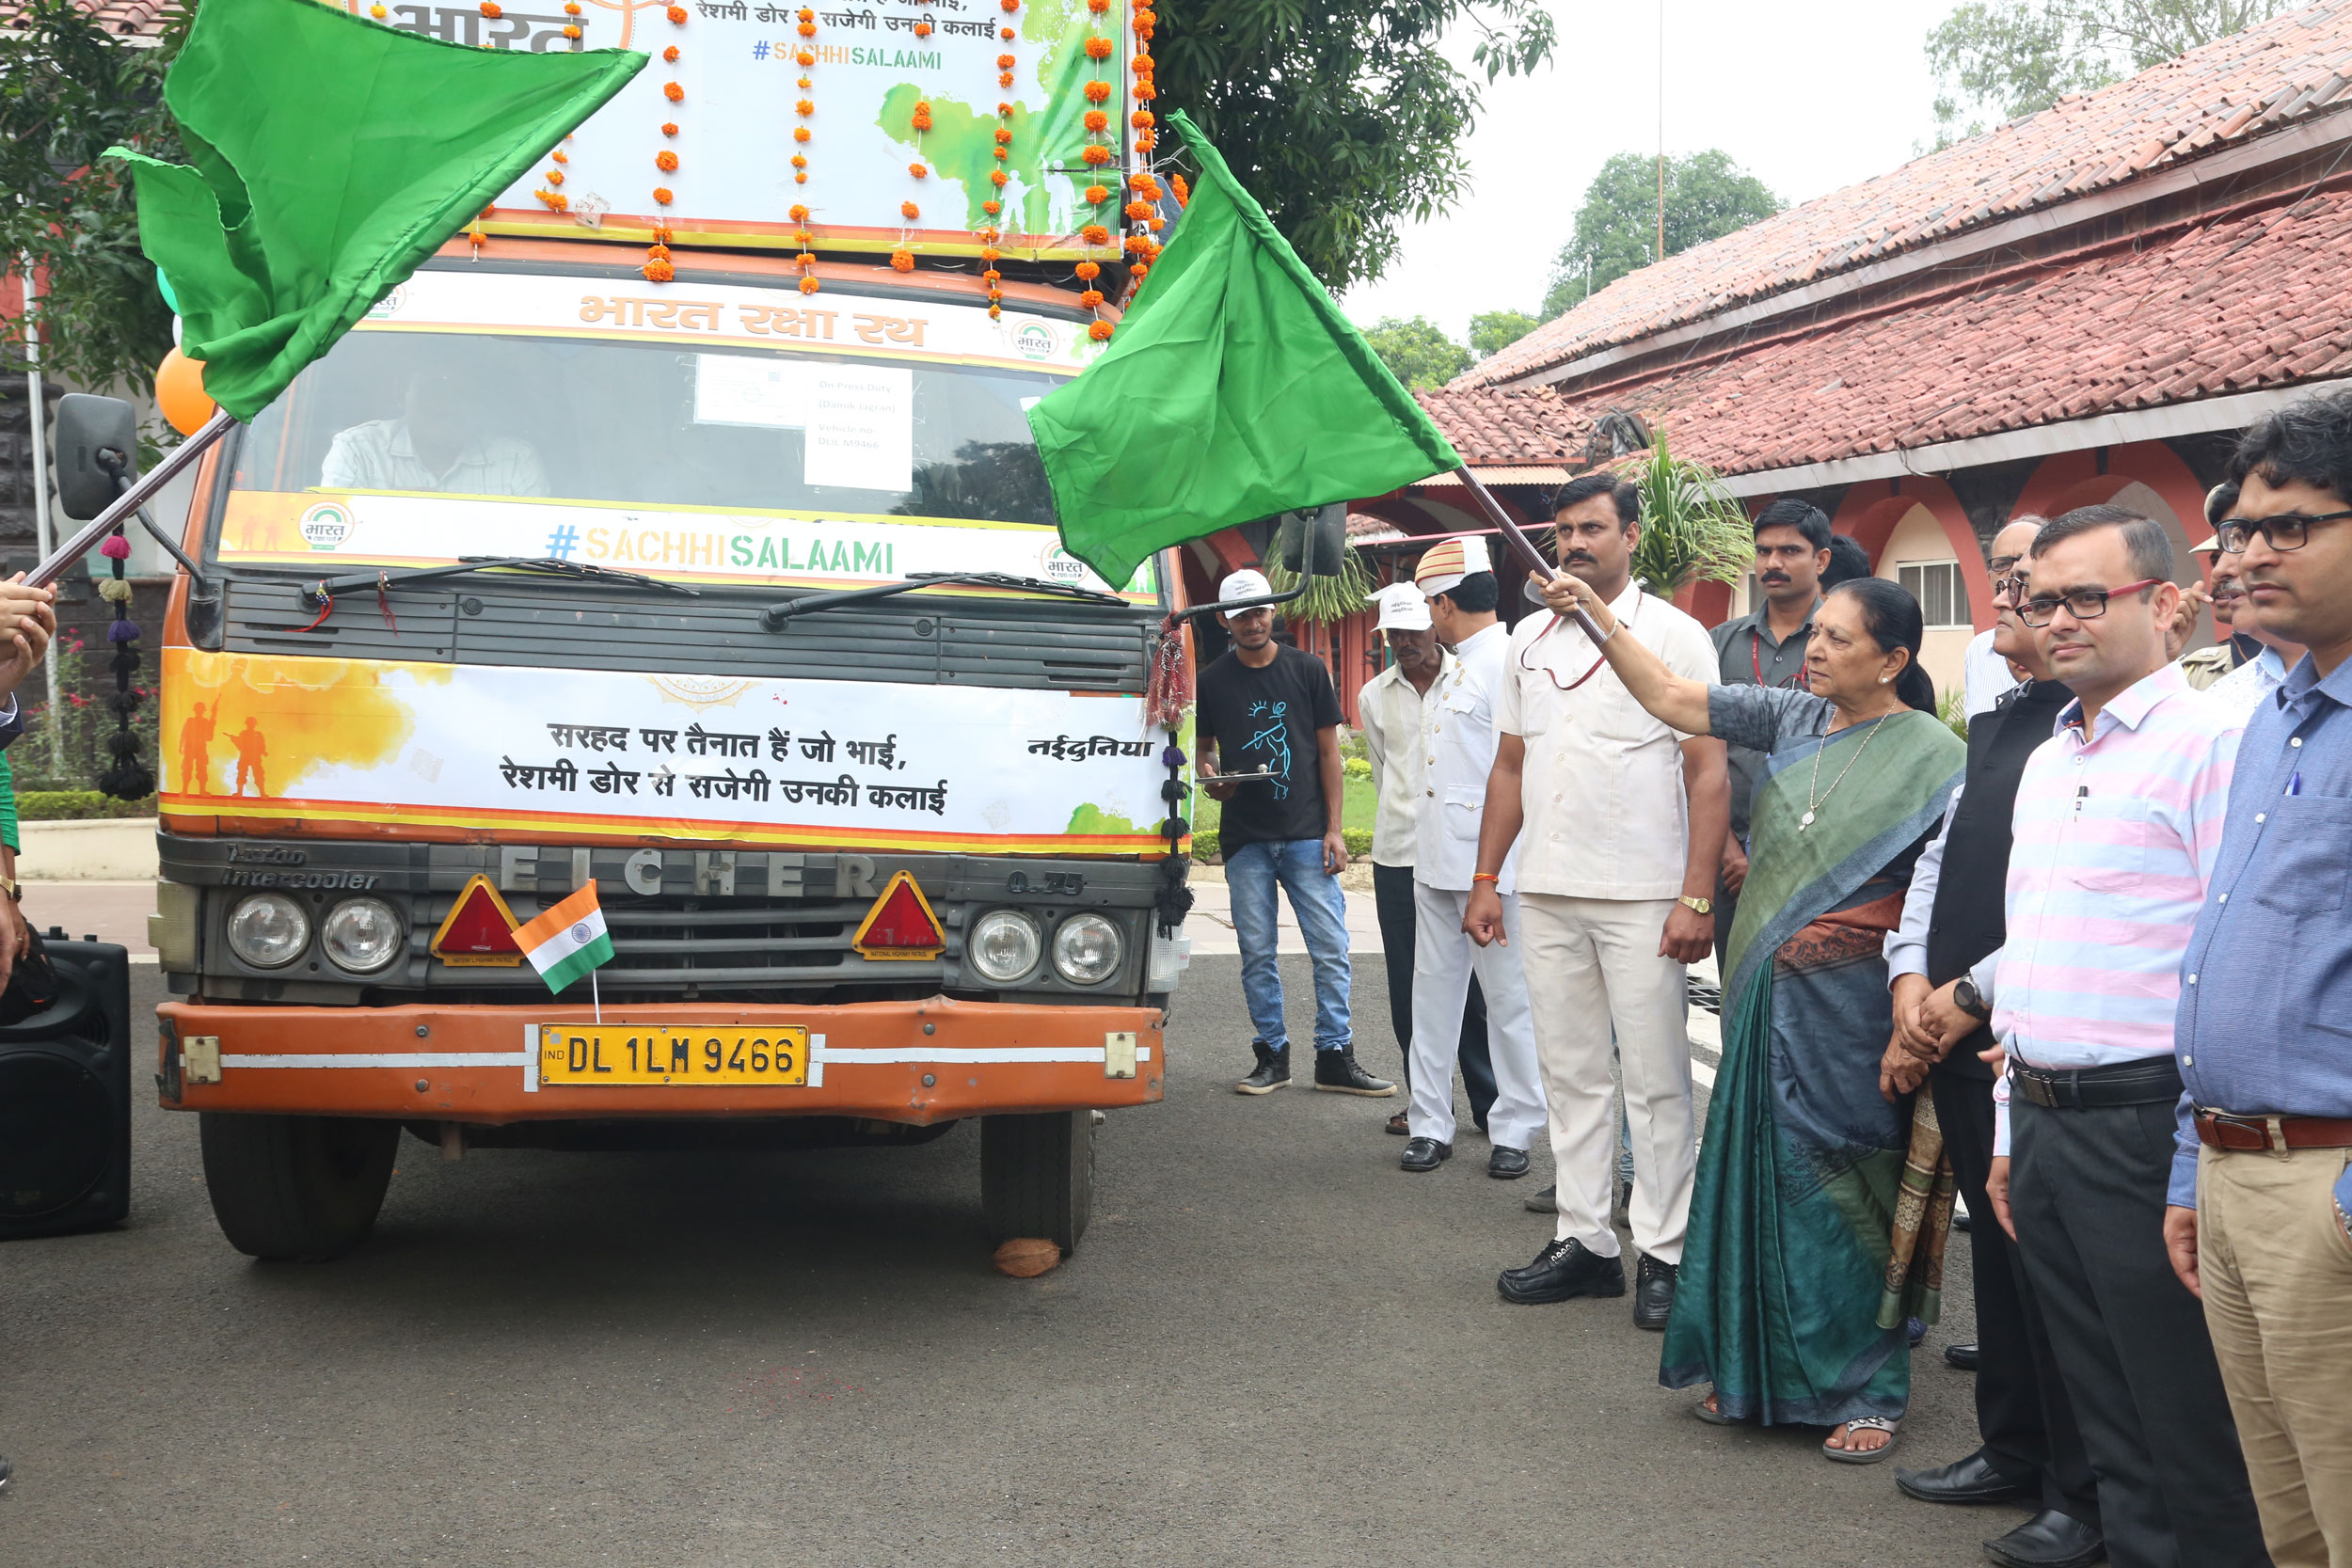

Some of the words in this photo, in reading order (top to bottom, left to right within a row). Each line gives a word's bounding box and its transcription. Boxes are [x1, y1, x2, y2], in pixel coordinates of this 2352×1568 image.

[754, 2, 789, 24] डोर
[819, 8, 877, 30] सजेगी
[941, 17, 996, 40] कलाई
[579, 294, 724, 331] भारत
[739, 303, 839, 340] रक्षा
[852, 312, 930, 347] रथ
[1018, 337, 1051, 349] भारत
[818, 380, 834, 388] On
[837, 382, 865, 391] Press
[867, 384, 892, 394] Duty
[818, 423, 856, 433] Vehicle
[306, 524, 345, 535] भारत
[1048, 562, 1082, 572] भारत
[547, 722, 630, 752] सरहद
[639, 728, 678, 754] पर
[685, 722, 760, 758] तैनात
[768, 726, 790, 763] हैं
[798, 729, 836, 763] जो
[846, 734, 906, 770] भाई,
[1027, 735, 1155, 763] नईदुनिया
[499, 754, 579, 792] रेशमी
[587, 760, 641, 795] डोर
[648, 763, 676, 797] से
[685, 768, 771, 802] सजेगी
[780, 773, 860, 807] उनकी
[866, 779, 948, 816] कलाई
[220, 866, 379, 891] Intercooler
[500, 845, 880, 897] EICHER
[544, 1049, 565, 1061] IND
[568, 1037, 612, 1073] DL
[703, 1037, 794, 1073] 9466
